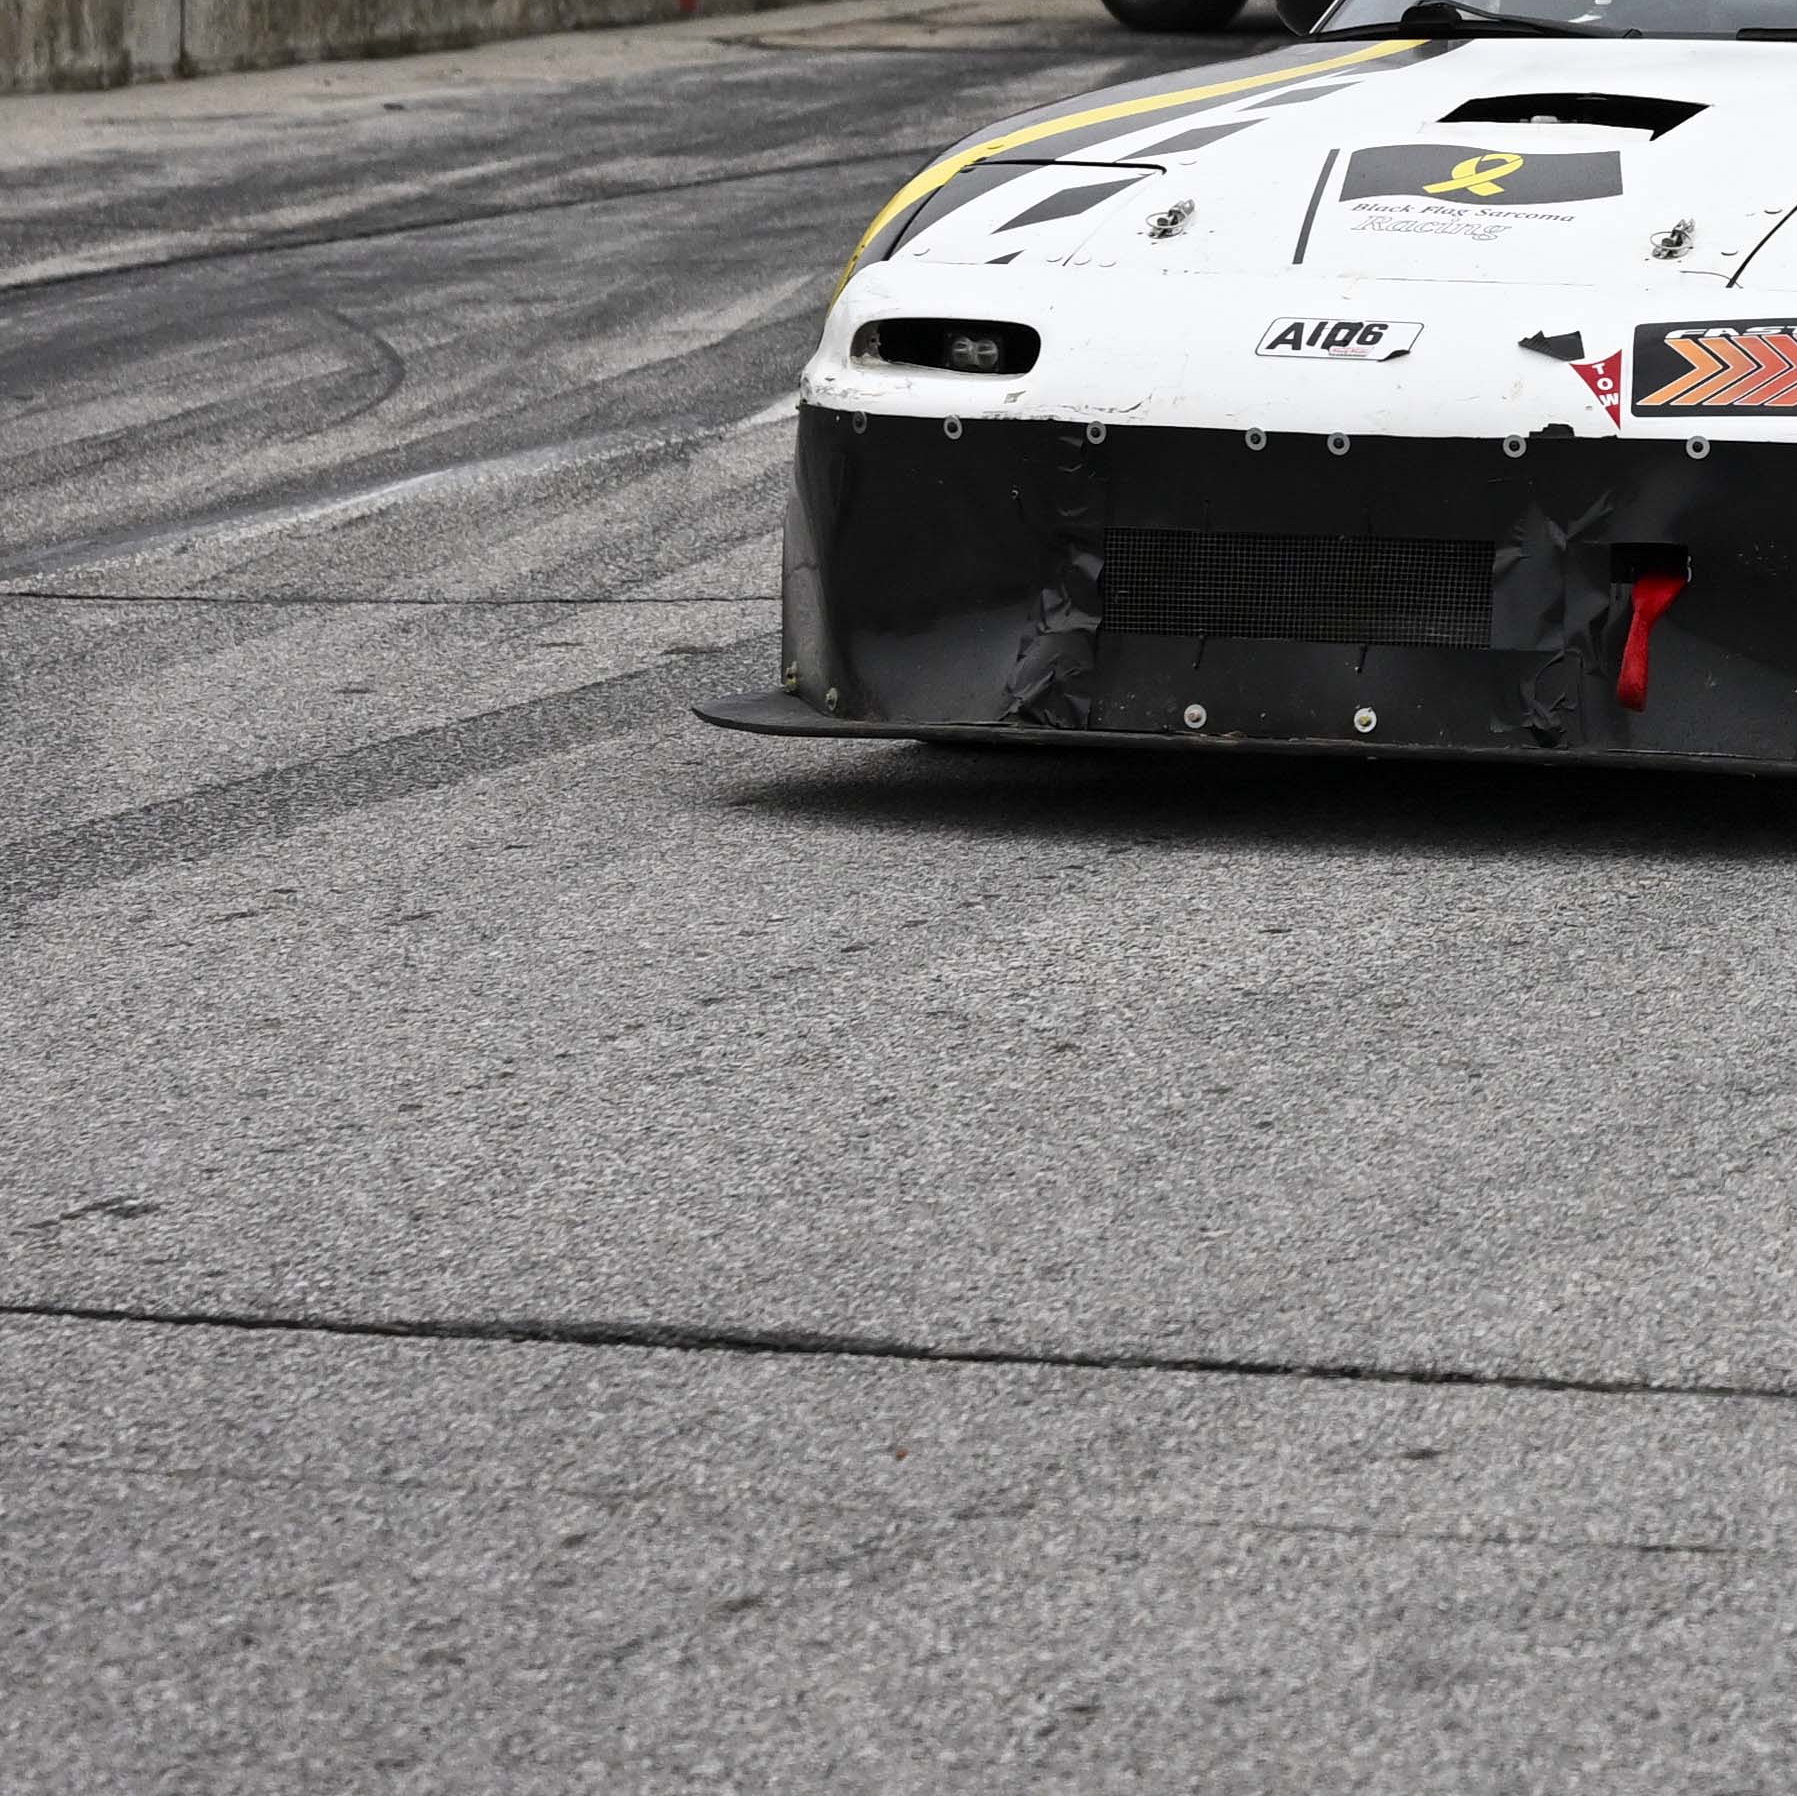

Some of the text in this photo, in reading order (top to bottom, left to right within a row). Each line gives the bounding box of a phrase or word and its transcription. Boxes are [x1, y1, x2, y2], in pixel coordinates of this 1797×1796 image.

[1351, 202, 1577, 222] Black Flag Sarcoma
[1350, 216, 1513, 241] Racing
[1591, 362, 1619, 407] TOW
